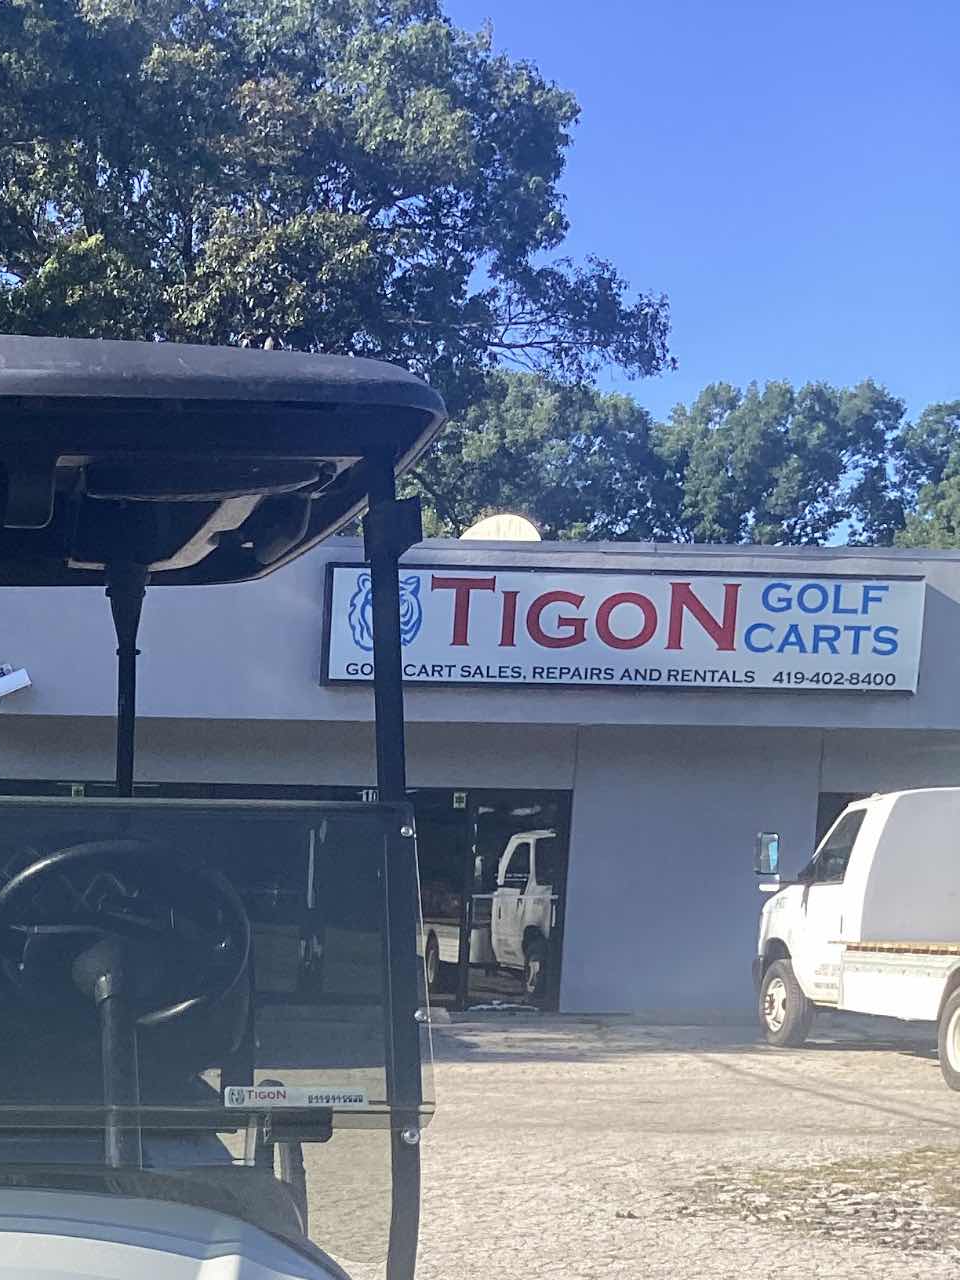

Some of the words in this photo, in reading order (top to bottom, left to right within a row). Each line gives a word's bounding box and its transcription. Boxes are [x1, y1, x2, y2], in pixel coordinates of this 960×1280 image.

[431, 573, 742, 651] TIGON
[761, 582, 890, 615] GOLF
[744, 622, 900, 656] CARTS
[346, 662, 375, 676] GO
[403, 663, 456, 678] CART
[460, 665, 527, 681] SALES,
[532, 666, 615, 681] REPAIRS
[620, 668, 662, 682] AND
[667, 669, 757, 684] RENTALS
[772, 671, 897, 687] 419-402-8400
[247, 1089, 287, 1100] TIGON
